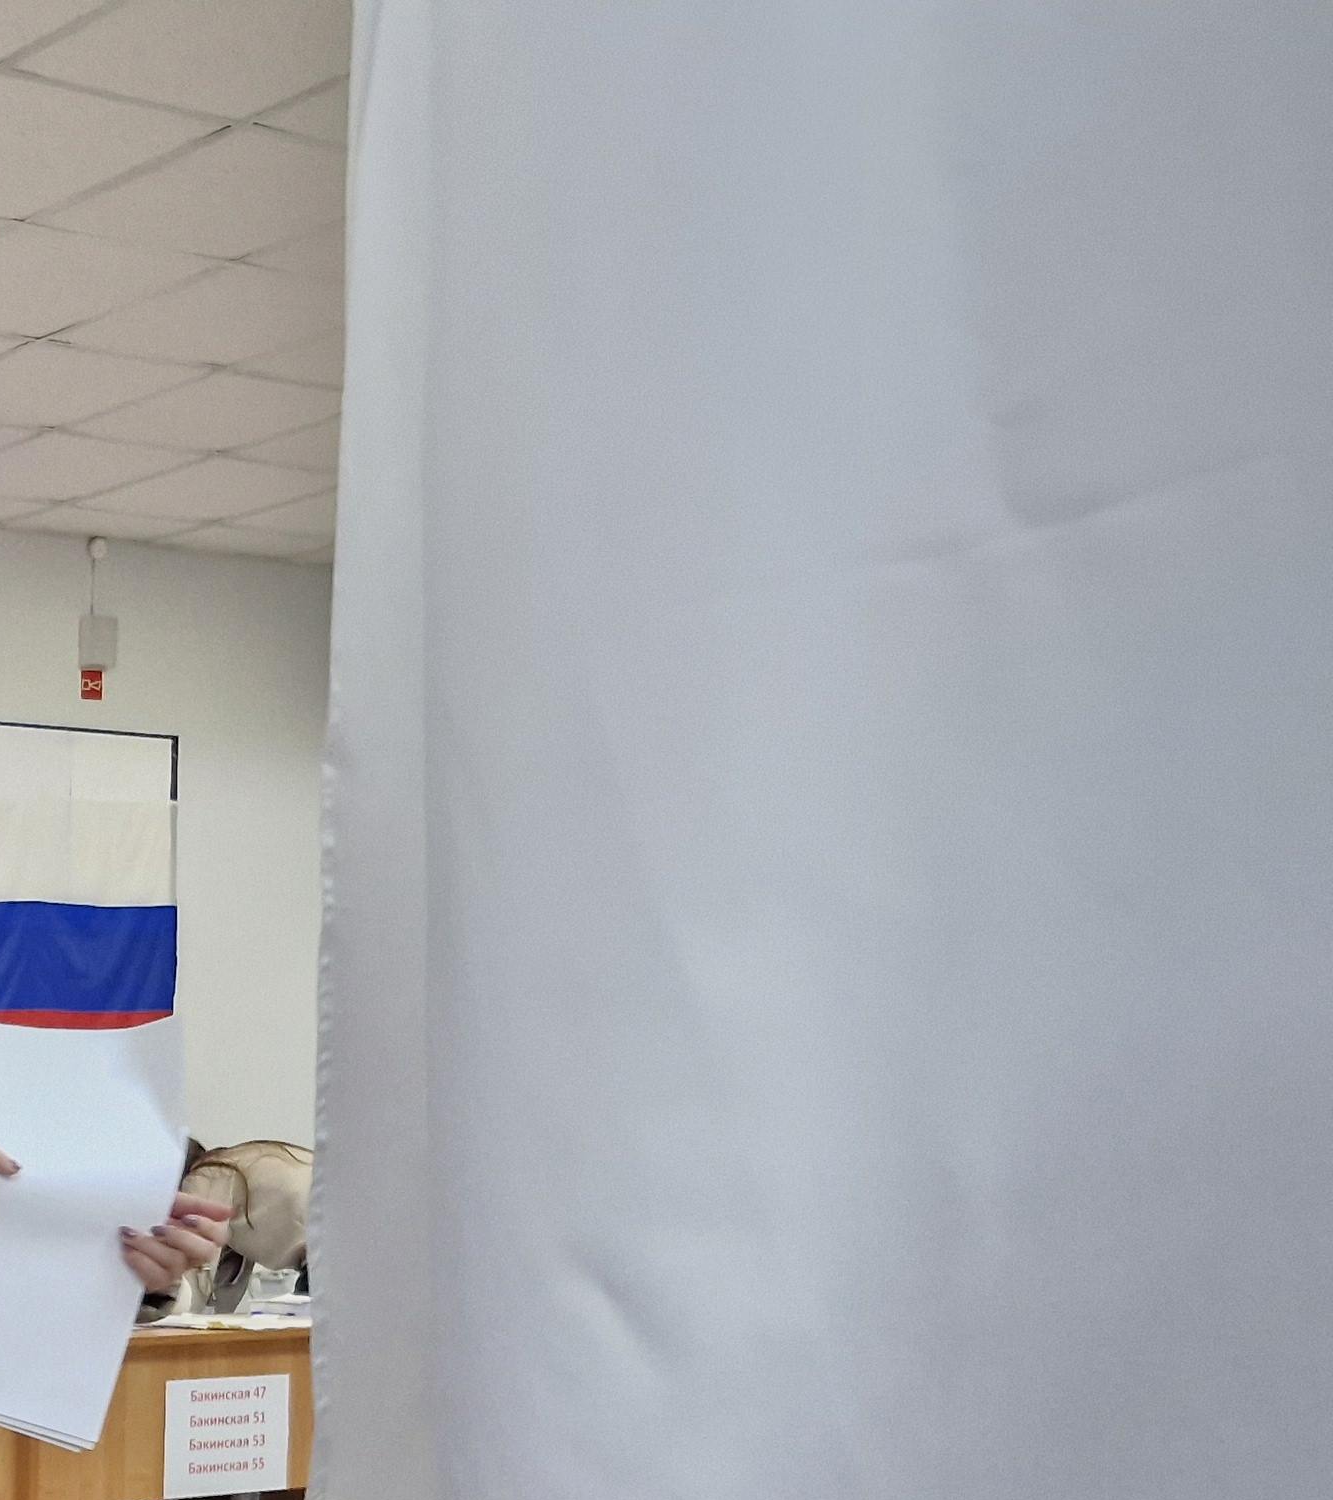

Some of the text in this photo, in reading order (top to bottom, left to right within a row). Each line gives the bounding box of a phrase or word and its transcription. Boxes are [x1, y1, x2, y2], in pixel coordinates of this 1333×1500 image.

[190, 1385, 267, 1402] Бакинская 47
[189, 1411, 265, 1428] Бакинская 51
[189, 1434, 265, 1451] Бакинская 53
[188, 1457, 265, 1475] Бакинская 55
